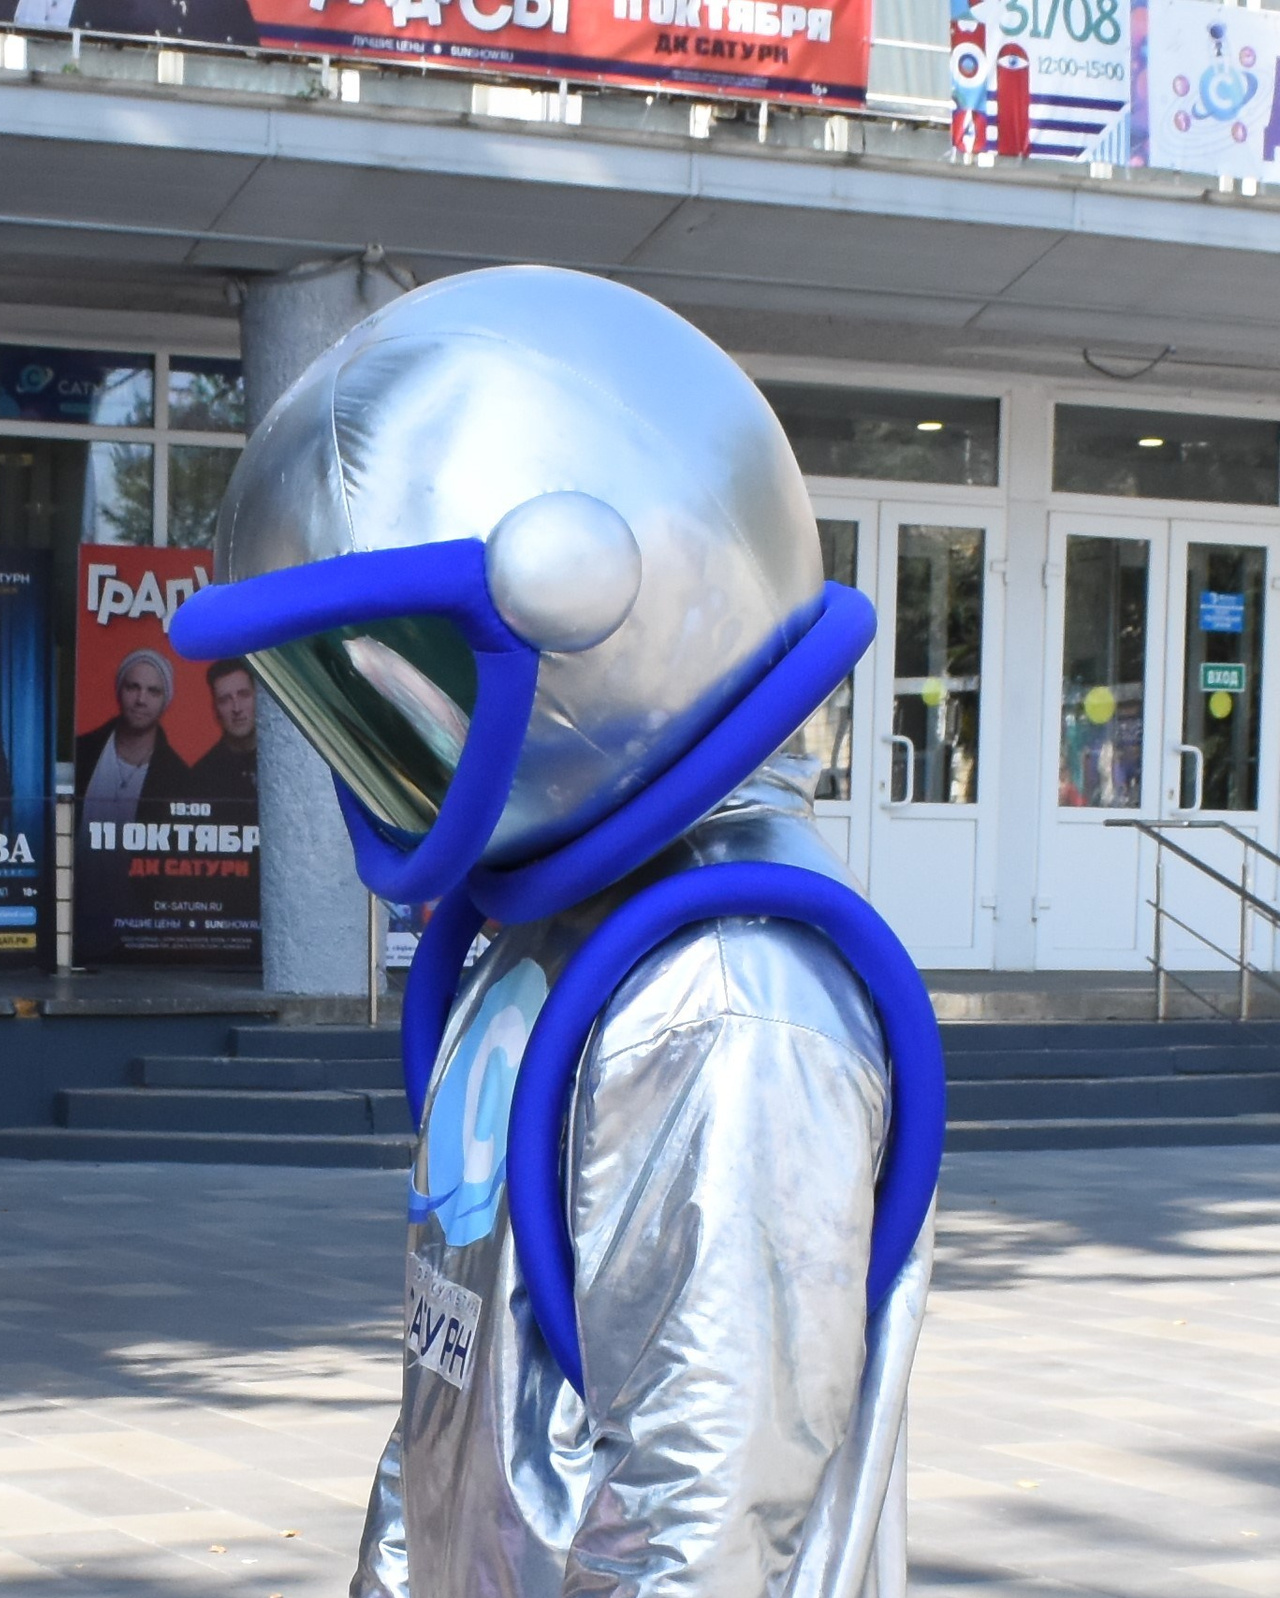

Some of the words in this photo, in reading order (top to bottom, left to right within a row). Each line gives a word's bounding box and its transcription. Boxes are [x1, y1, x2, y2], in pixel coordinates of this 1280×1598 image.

[649, 0, 833, 42] ОКТЯБРЯ
[999, 0, 1121, 45] 31/08
[654, 33, 689, 55] ДК
[695, 36, 790, 64] САТУРН
[1036, 55, 1125, 81] 12:00-15:00
[1207, 669, 1239, 687] ВХОД
[89, 821, 116, 850] 11
[122, 822, 260, 853] ОКТЯБР
[128, 858, 161, 877] ДК
[164, 858, 250, 877] САТУРН
[22, 887, 38, 897] 18+
[153, 901, 224, 912] DK-SATURN.RU
[406, 1286, 472, 1381] АУРН
